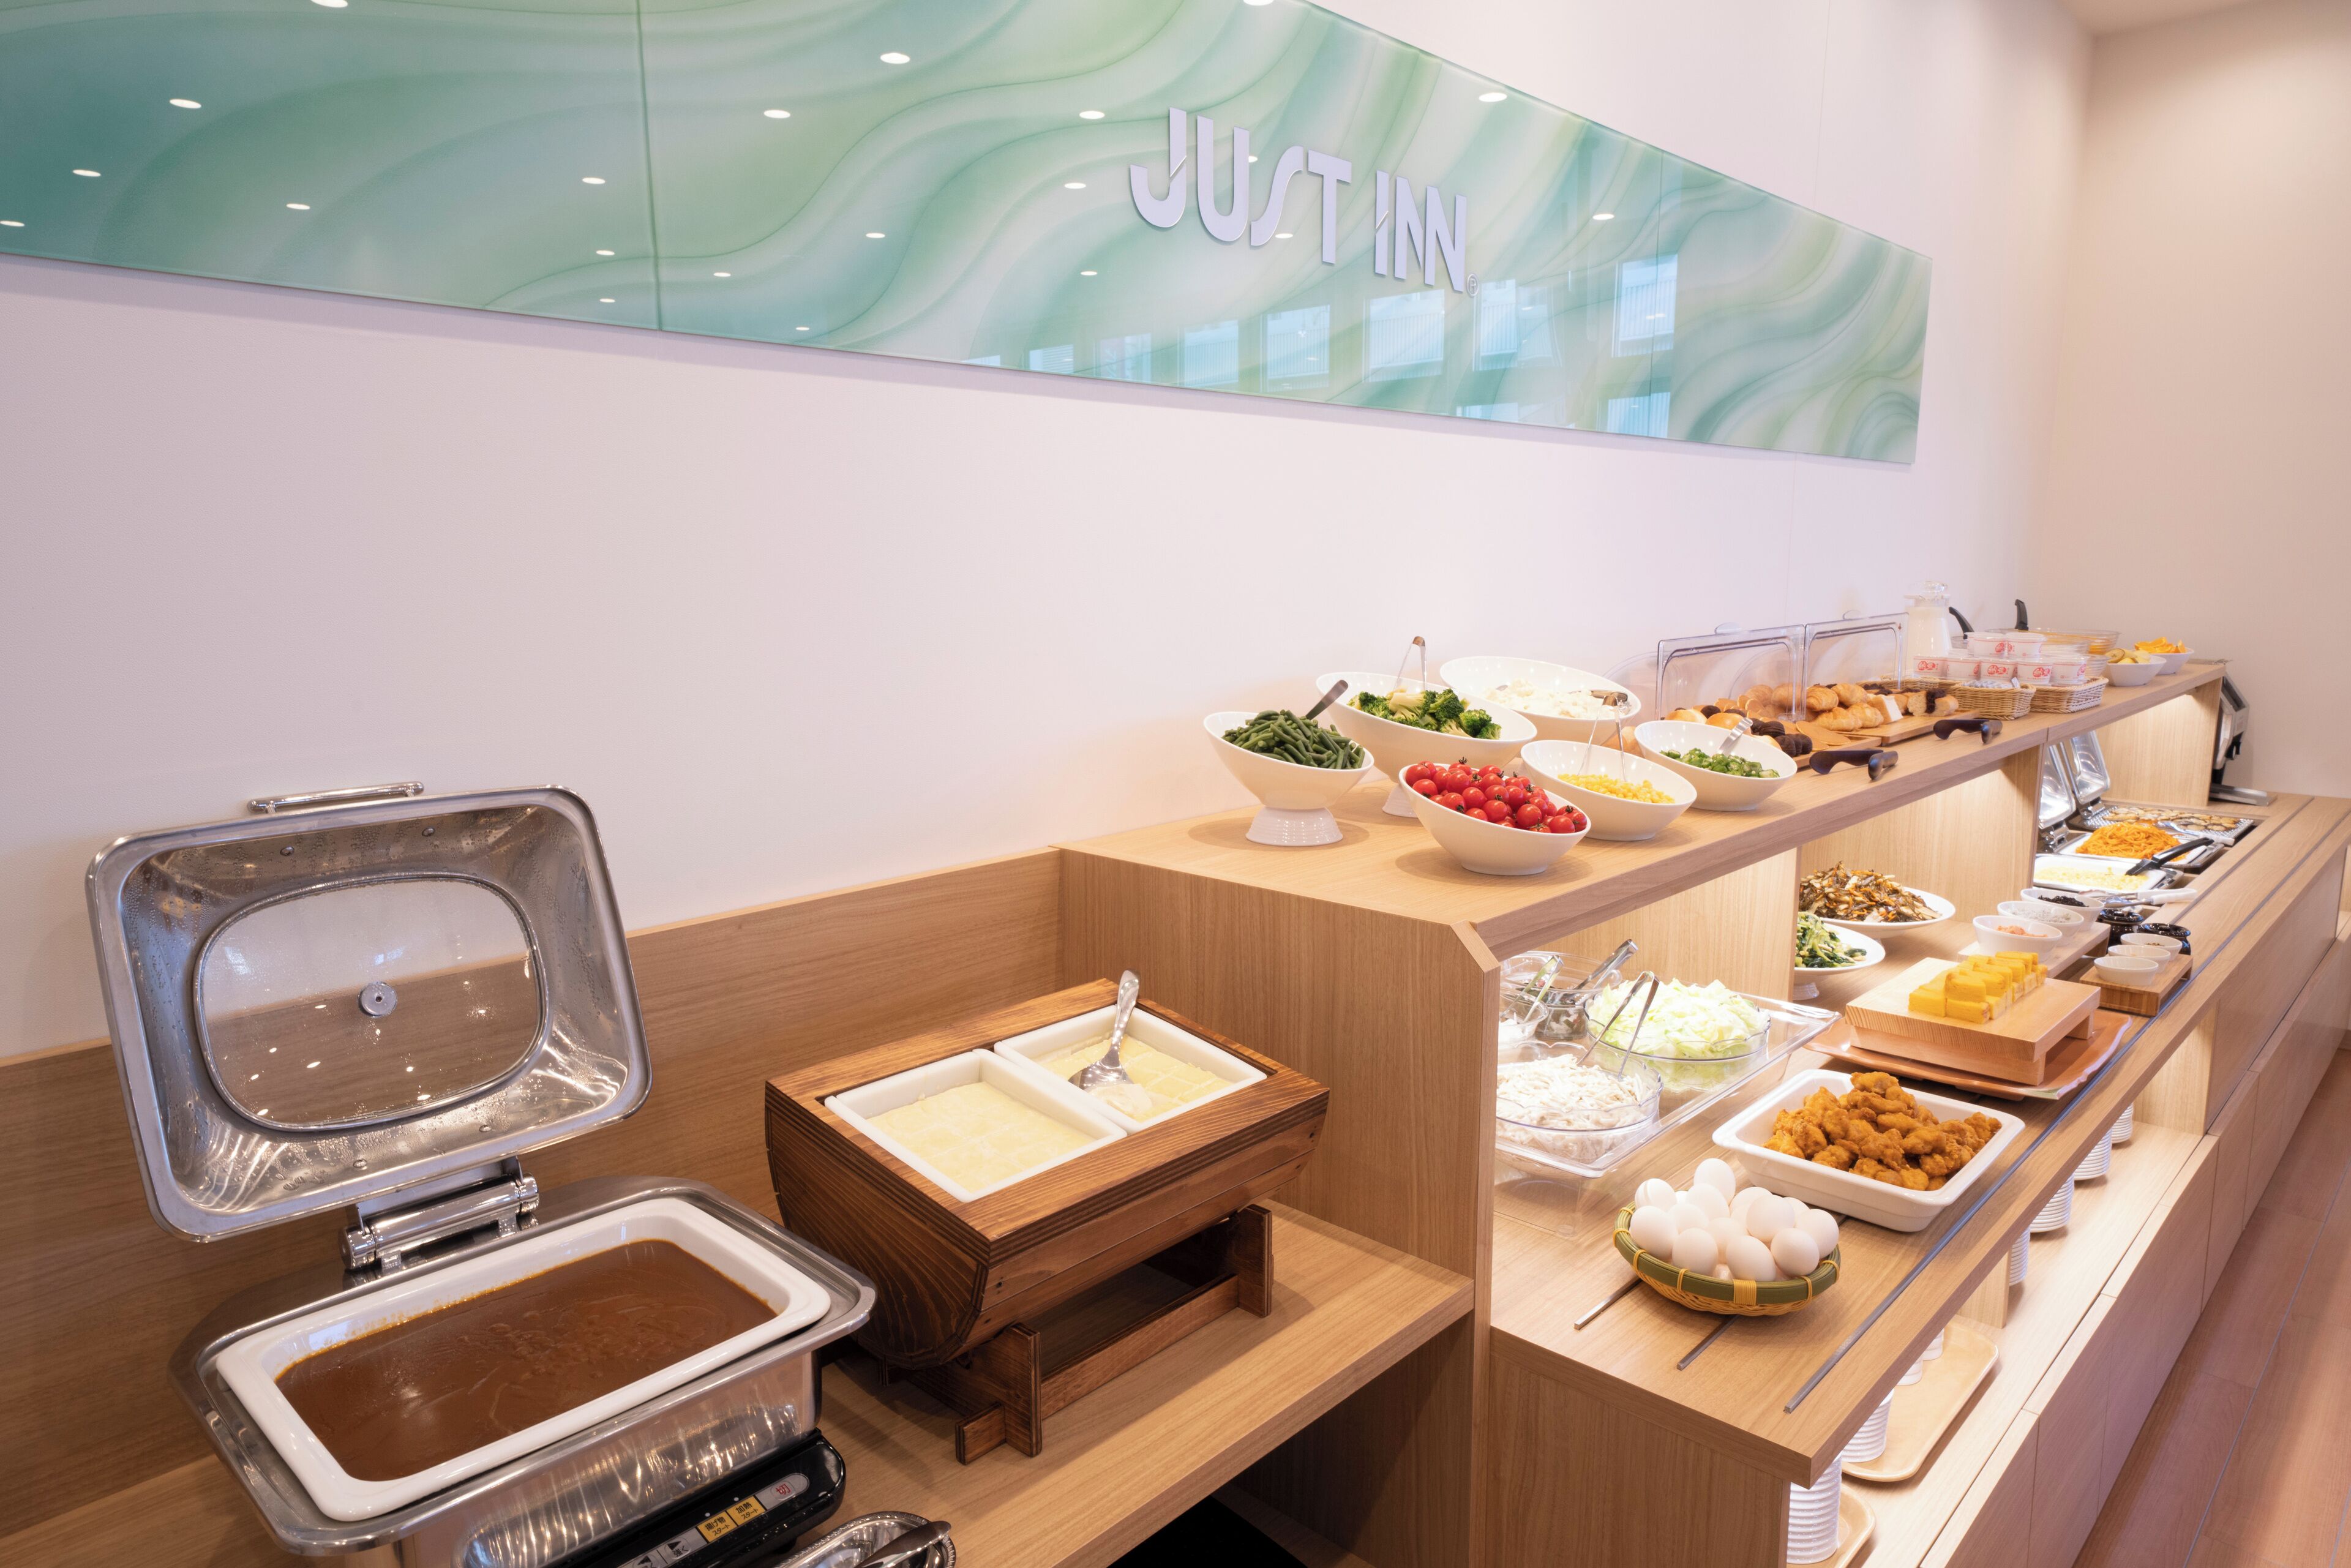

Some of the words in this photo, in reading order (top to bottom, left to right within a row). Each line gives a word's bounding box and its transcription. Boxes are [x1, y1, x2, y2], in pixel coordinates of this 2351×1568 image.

[1130, 107, 1352, 264] JUST
[1374, 170, 1467, 293] INN
[775, 1484, 792, 1495] 切
[735, 1501, 753, 1514] 加熱
[741, 1508, 759, 1520] スタート
[705, 1516, 726, 1531] 揚げ物
[711, 1524, 730, 1536] スタート
